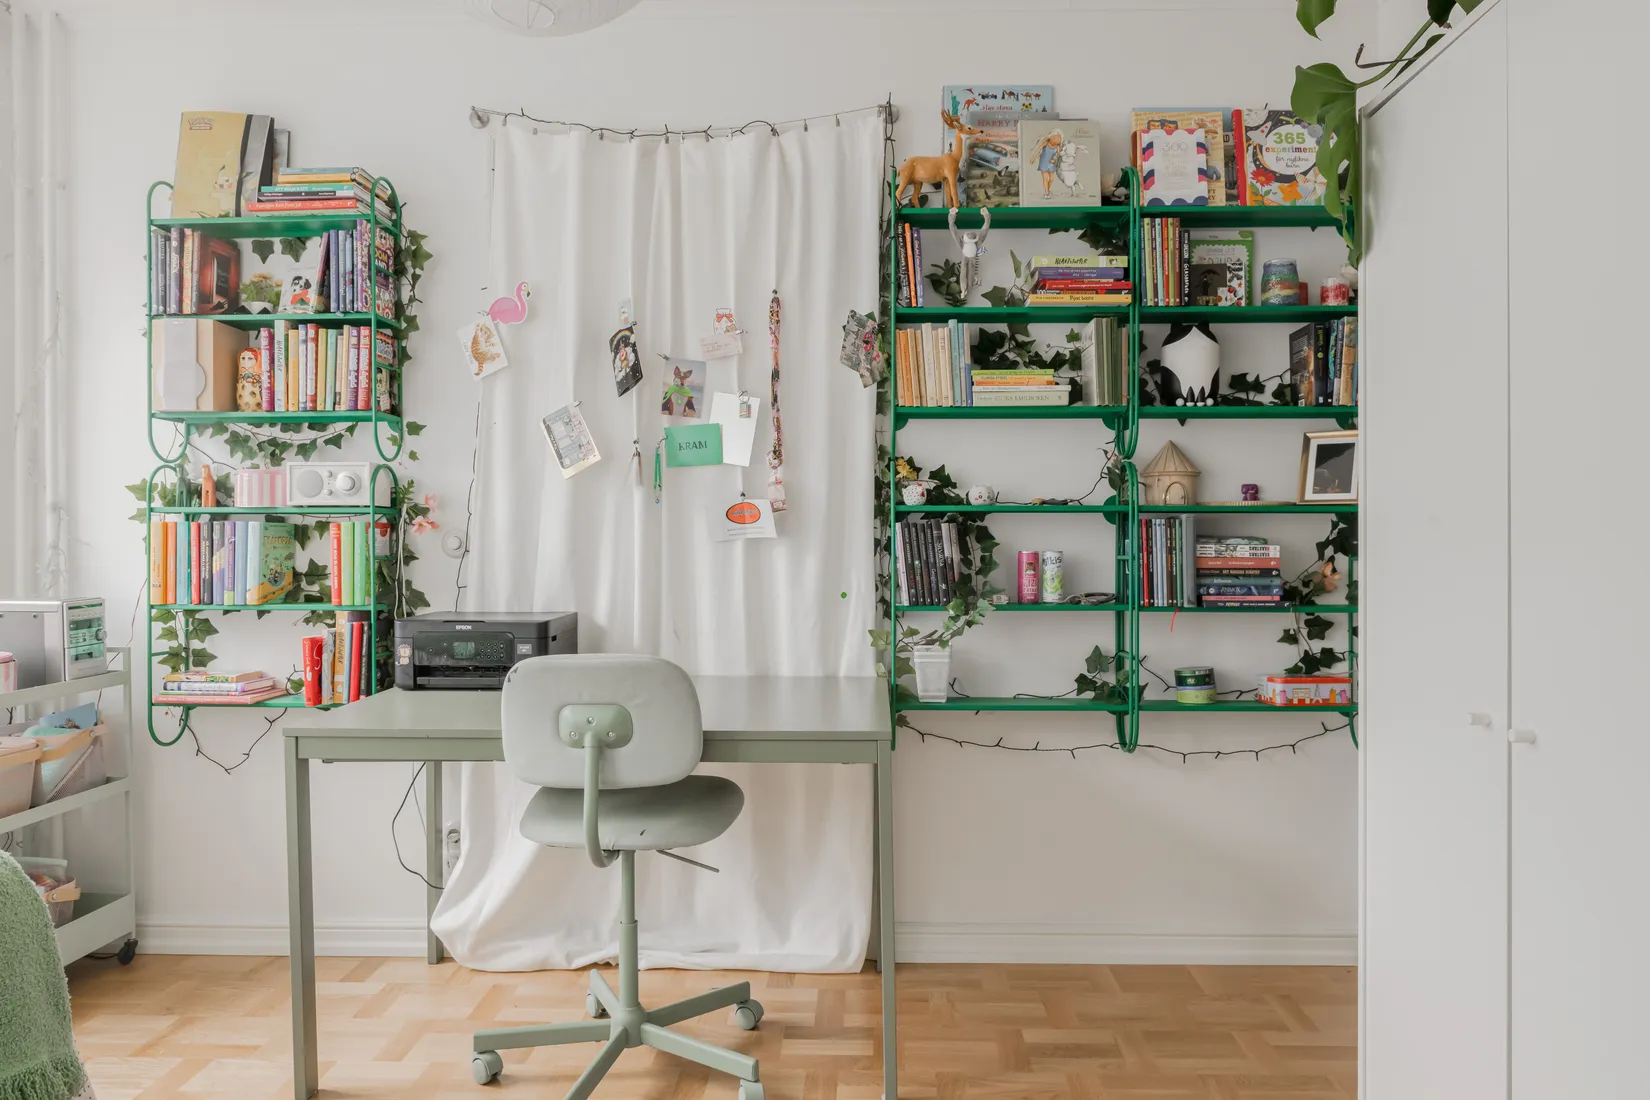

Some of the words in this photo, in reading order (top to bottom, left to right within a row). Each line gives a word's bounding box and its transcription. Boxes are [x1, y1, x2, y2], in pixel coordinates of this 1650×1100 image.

[977, 119, 1010, 127] HARRY
[1273, 131, 1306, 145] 365
[678, 440, 708, 451] KRAM
